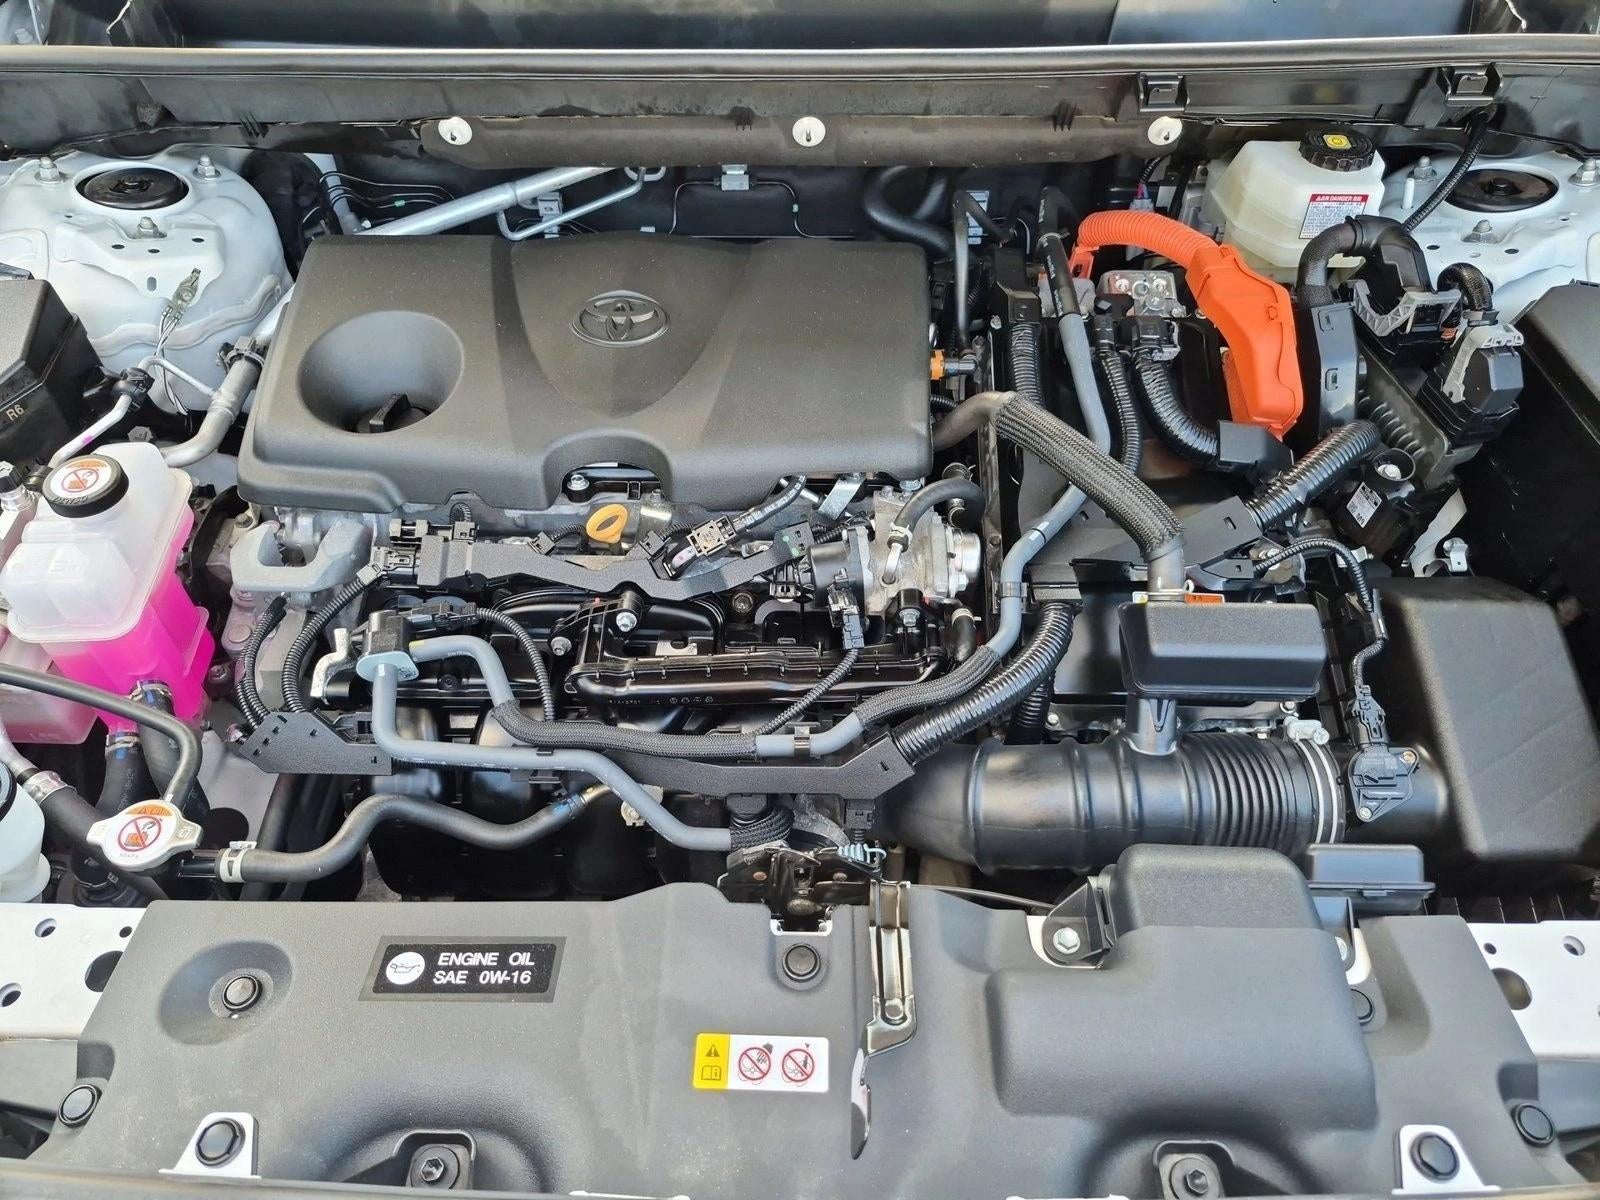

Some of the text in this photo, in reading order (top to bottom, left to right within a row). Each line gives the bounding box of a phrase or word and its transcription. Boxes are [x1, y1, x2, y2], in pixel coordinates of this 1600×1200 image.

[6, 404, 25, 421] R6
[437, 952, 535, 966] ENGINE OIL
[433, 970, 532, 985] SAE 0W-16
